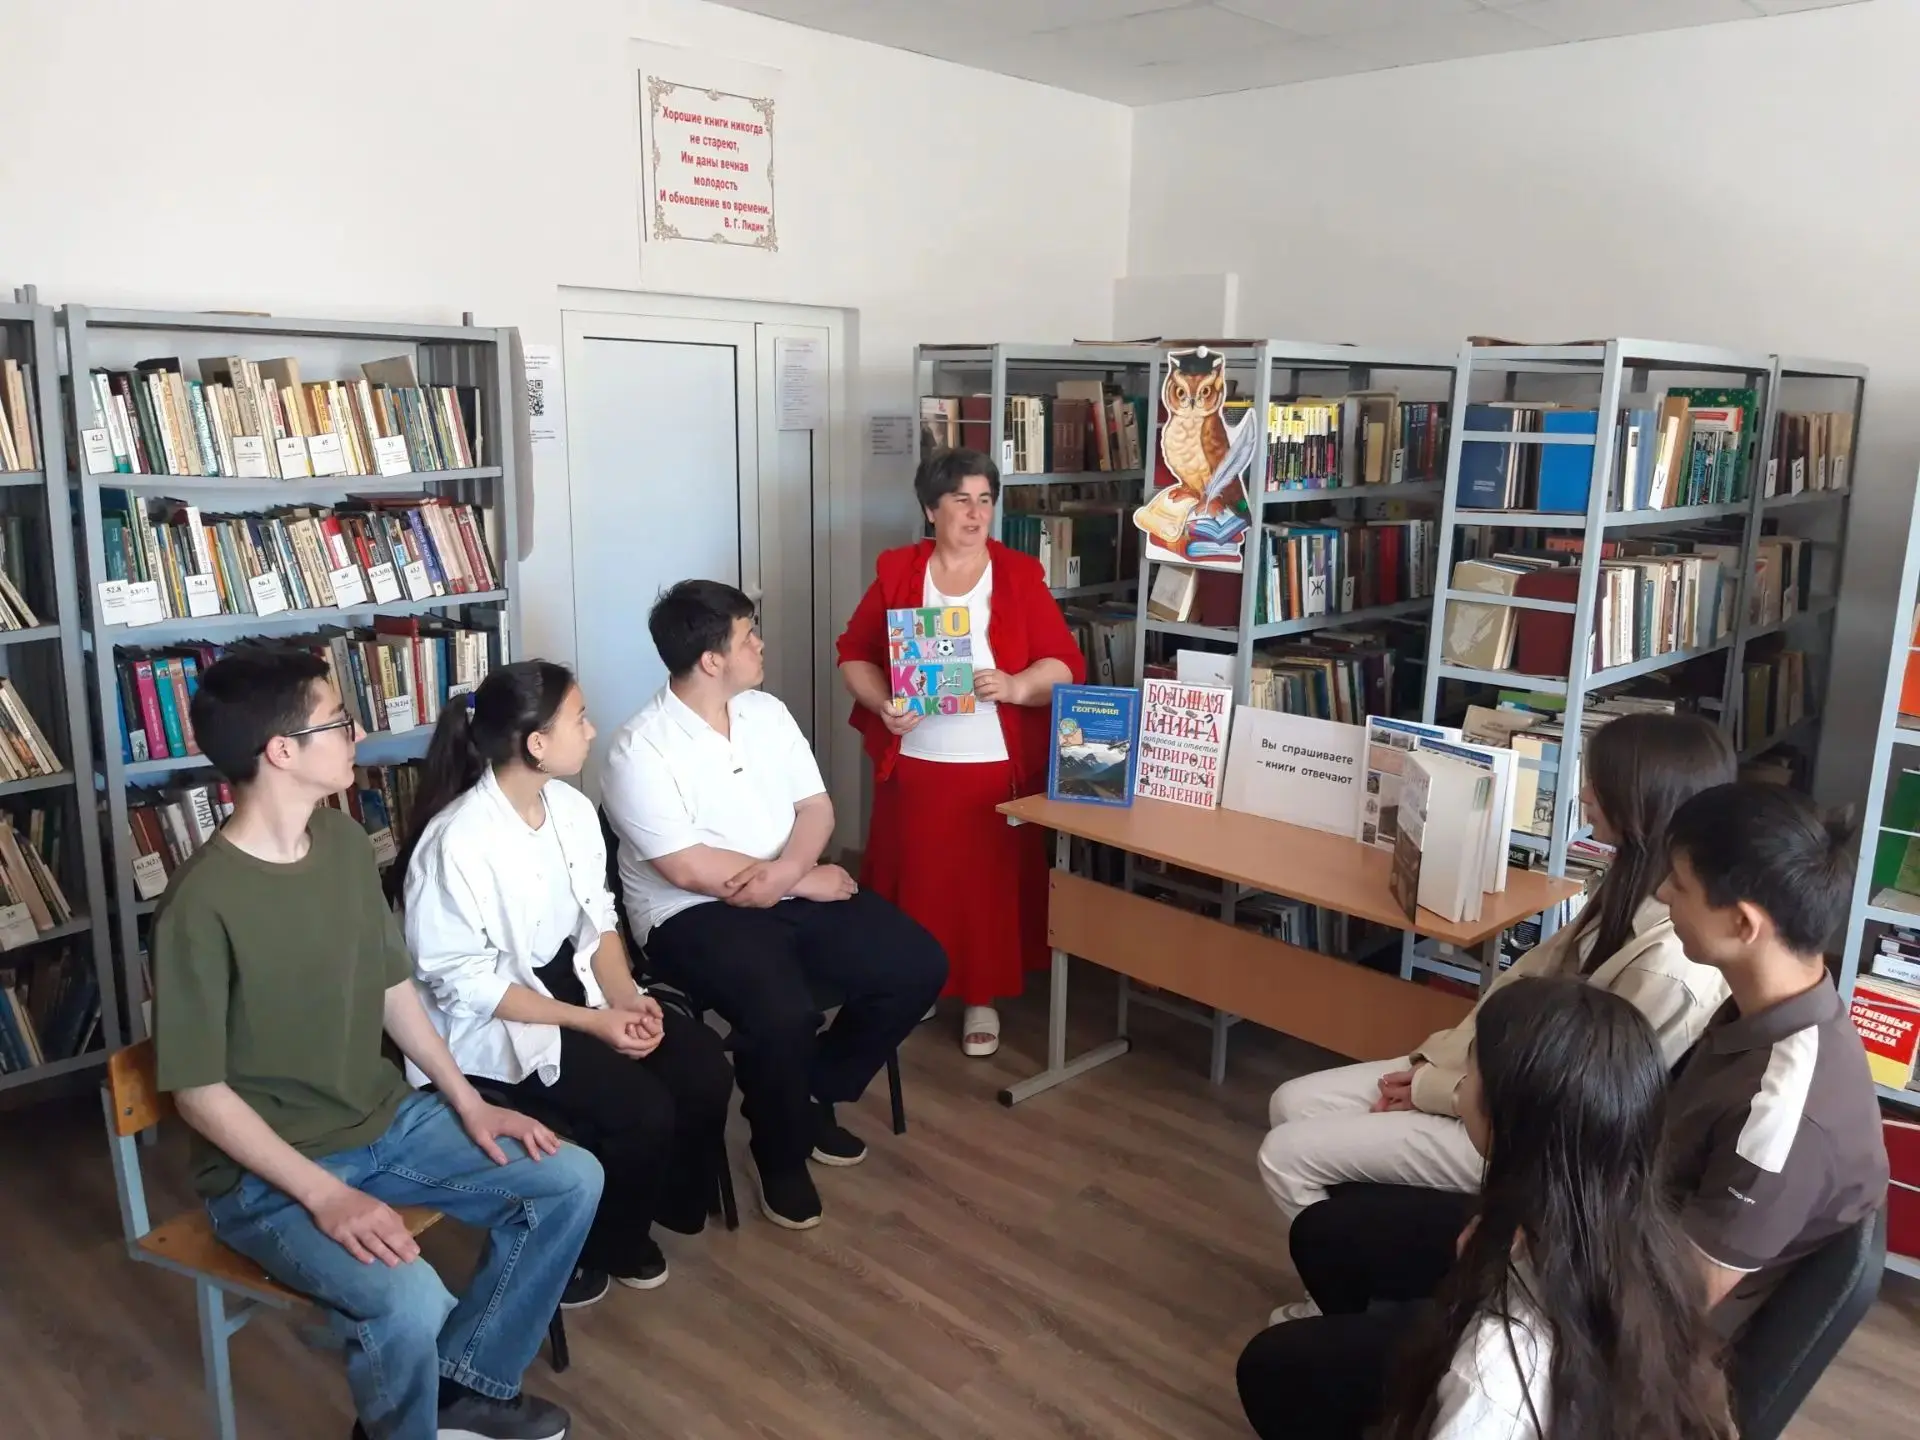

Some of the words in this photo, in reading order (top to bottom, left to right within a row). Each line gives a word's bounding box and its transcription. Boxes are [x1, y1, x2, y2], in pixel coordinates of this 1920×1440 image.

[662, 106, 702, 125] Хорошие
[704, 116, 729, 129] книги
[730, 121, 764, 136] никогда
[690, 135, 701, 145] не
[703, 136, 740, 153] стареют,
[681, 151, 694, 165] Им
[696, 156, 719, 169] даны
[720, 161, 749, 173] вечная
[693, 175, 739, 191] молодость
[659, 189, 667, 202] И
[669, 191, 720, 209] обновление
[722, 199, 732, 211] во
[733, 202, 770, 216] времени.
[724, 216, 732, 229] В.
[734, 218, 741, 230] Г.
[742, 219, 765, 233] Лидин
[1795, 463, 1802, 479] Б
[1069, 560, 1079, 575] М
[1311, 580, 1325, 596] Ж
[1071, 705, 1119, 716] ГЕОГРАФИЯ
[1148, 683, 1225, 714] БОЛЬШАЯ
[1145, 711, 1220, 744] КНИГА
[1151, 746, 1217, 771] ПРИРОДЕ
[1261, 738, 1277, 750] Вы
[1282, 744, 1354, 765] спрашиваете
[1141, 761, 1215, 788] ВЕЩЕЙ
[1265, 760, 1296, 773] книги
[1301, 767, 1353, 785] отвечают
[1150, 782, 1213, 807] ЯВЛЕНИЙ
[194, 789, 214, 829] КНИГА
[1857, 1027, 1897, 1047] АВКАЗА
